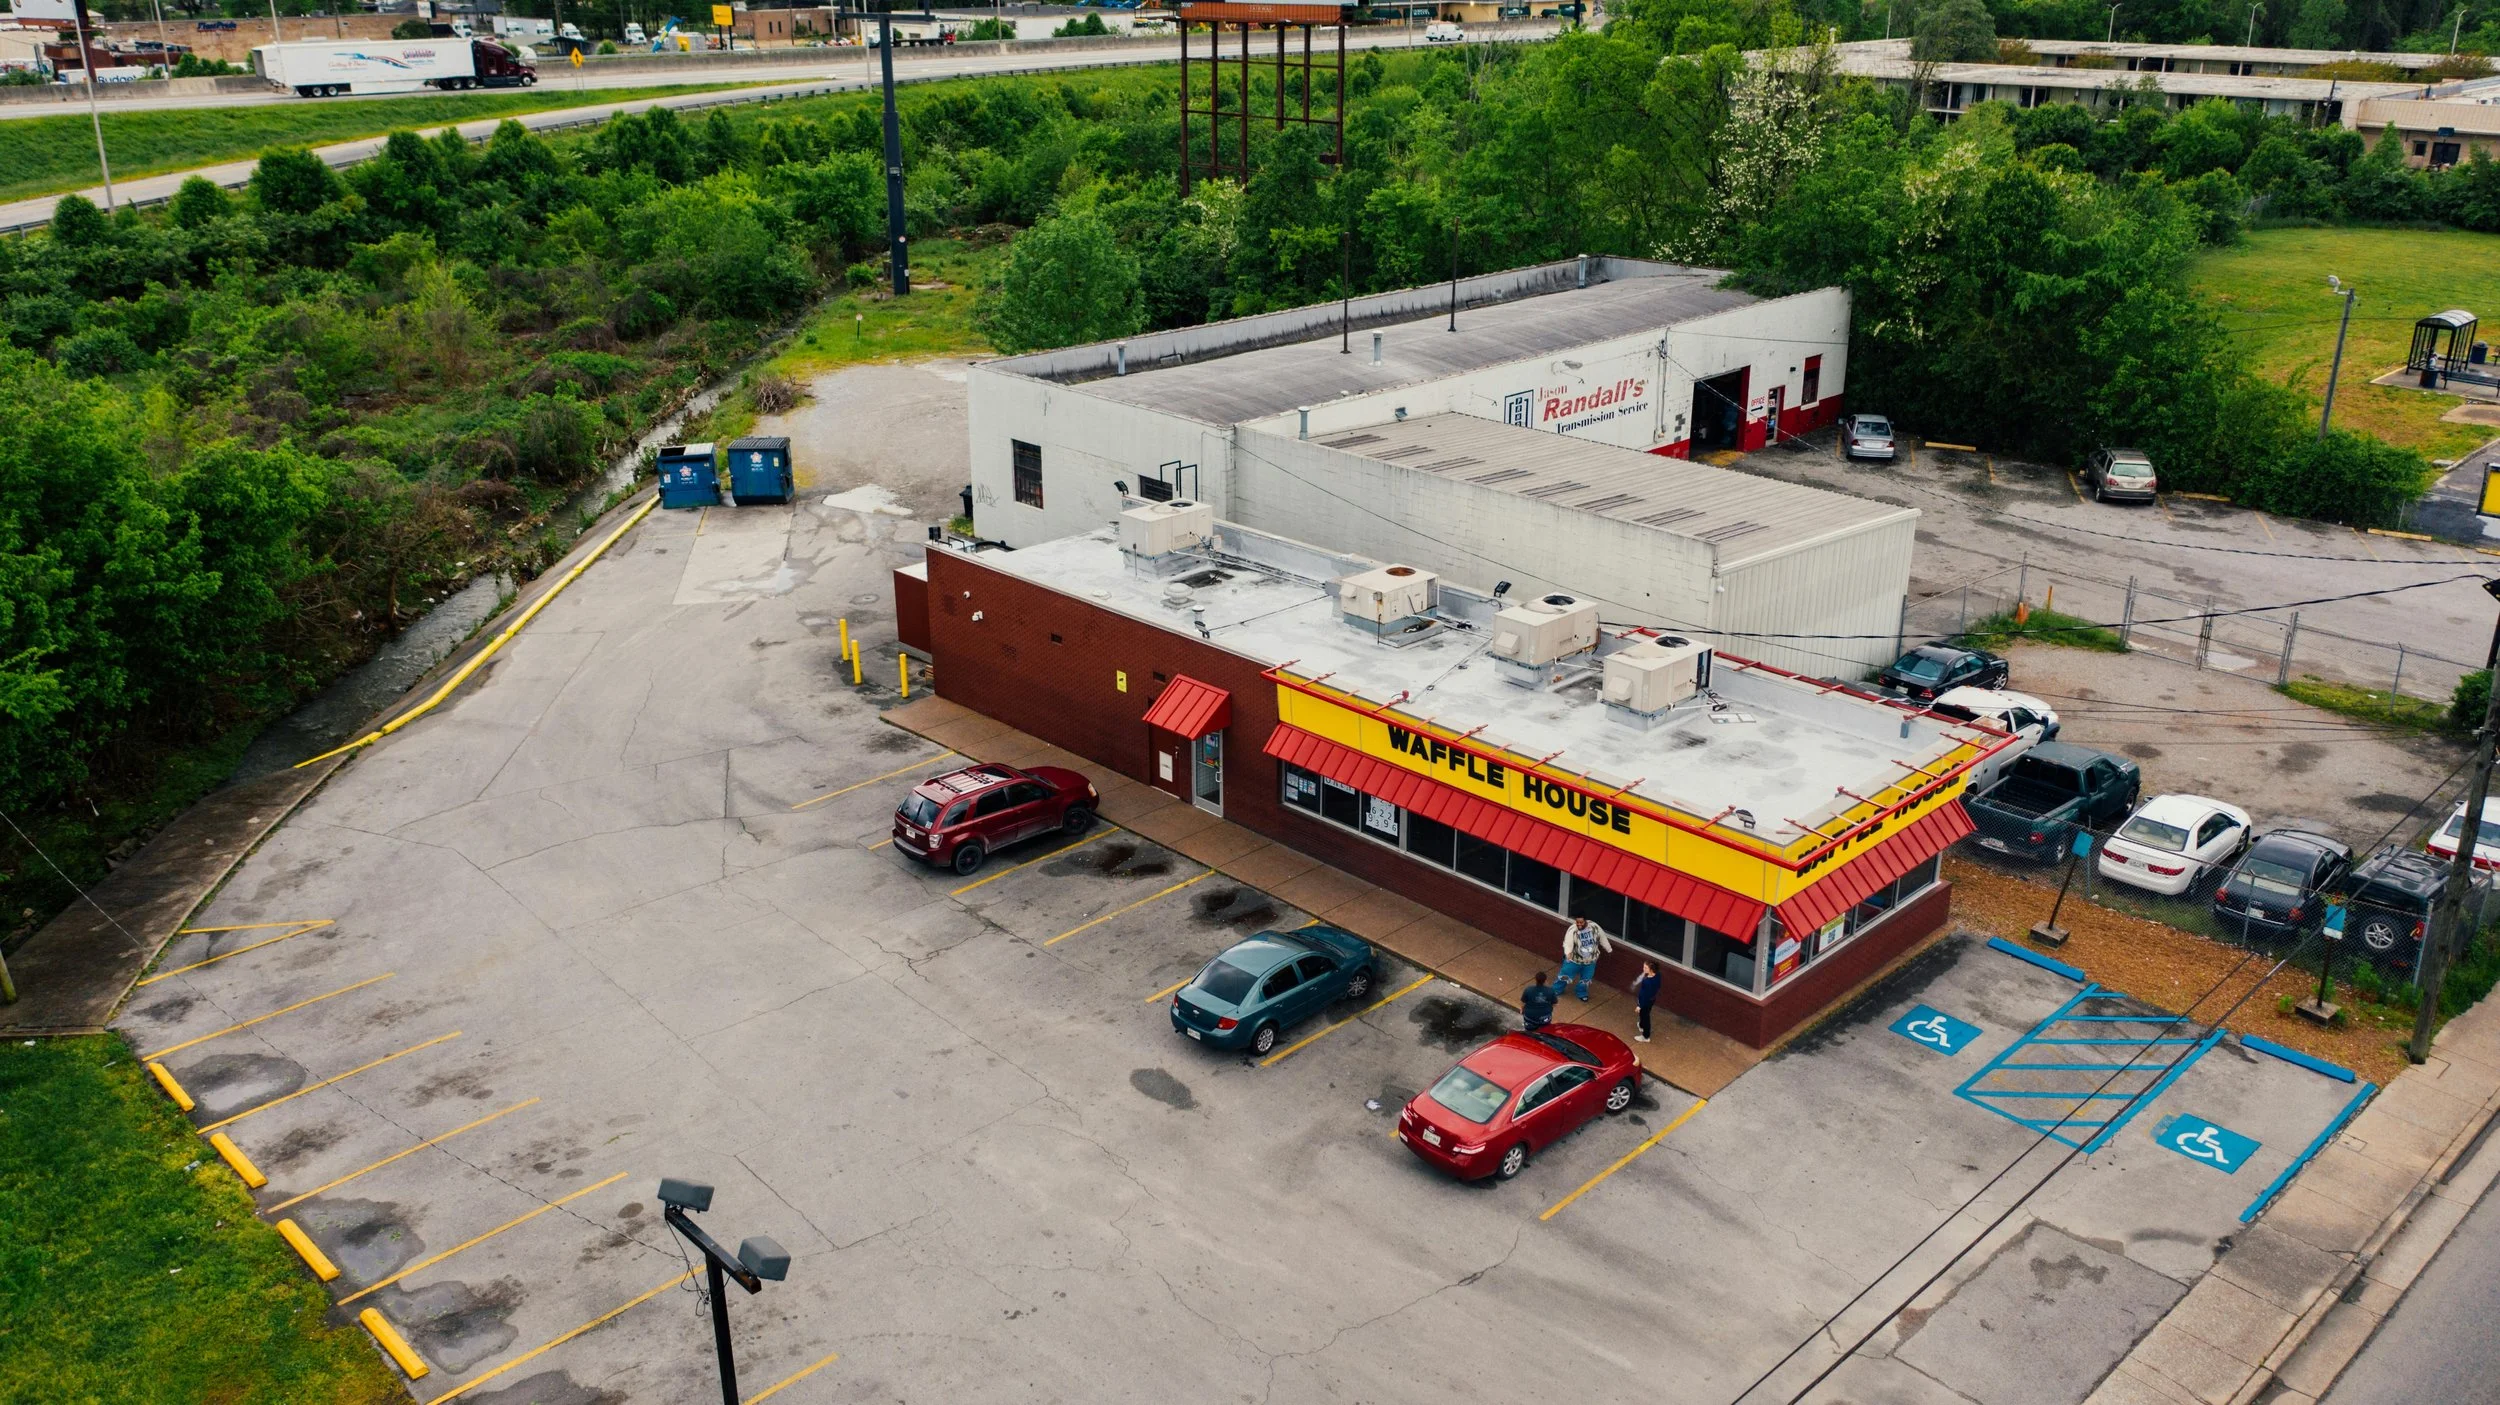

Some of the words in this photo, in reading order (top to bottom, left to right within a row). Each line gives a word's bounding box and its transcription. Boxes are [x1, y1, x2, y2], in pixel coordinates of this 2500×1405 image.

[1538, 384, 1568, 402] Jason
[1543, 378, 1645, 422] Randall's
[1556, 411, 1615, 434] Transmission
[1617, 401, 1649, 417] Service
[1388, 723, 1505, 788] WAFFLE
[1523, 774, 1631, 835] HOUSE
[1368, 813, 1397, 832] 9396
